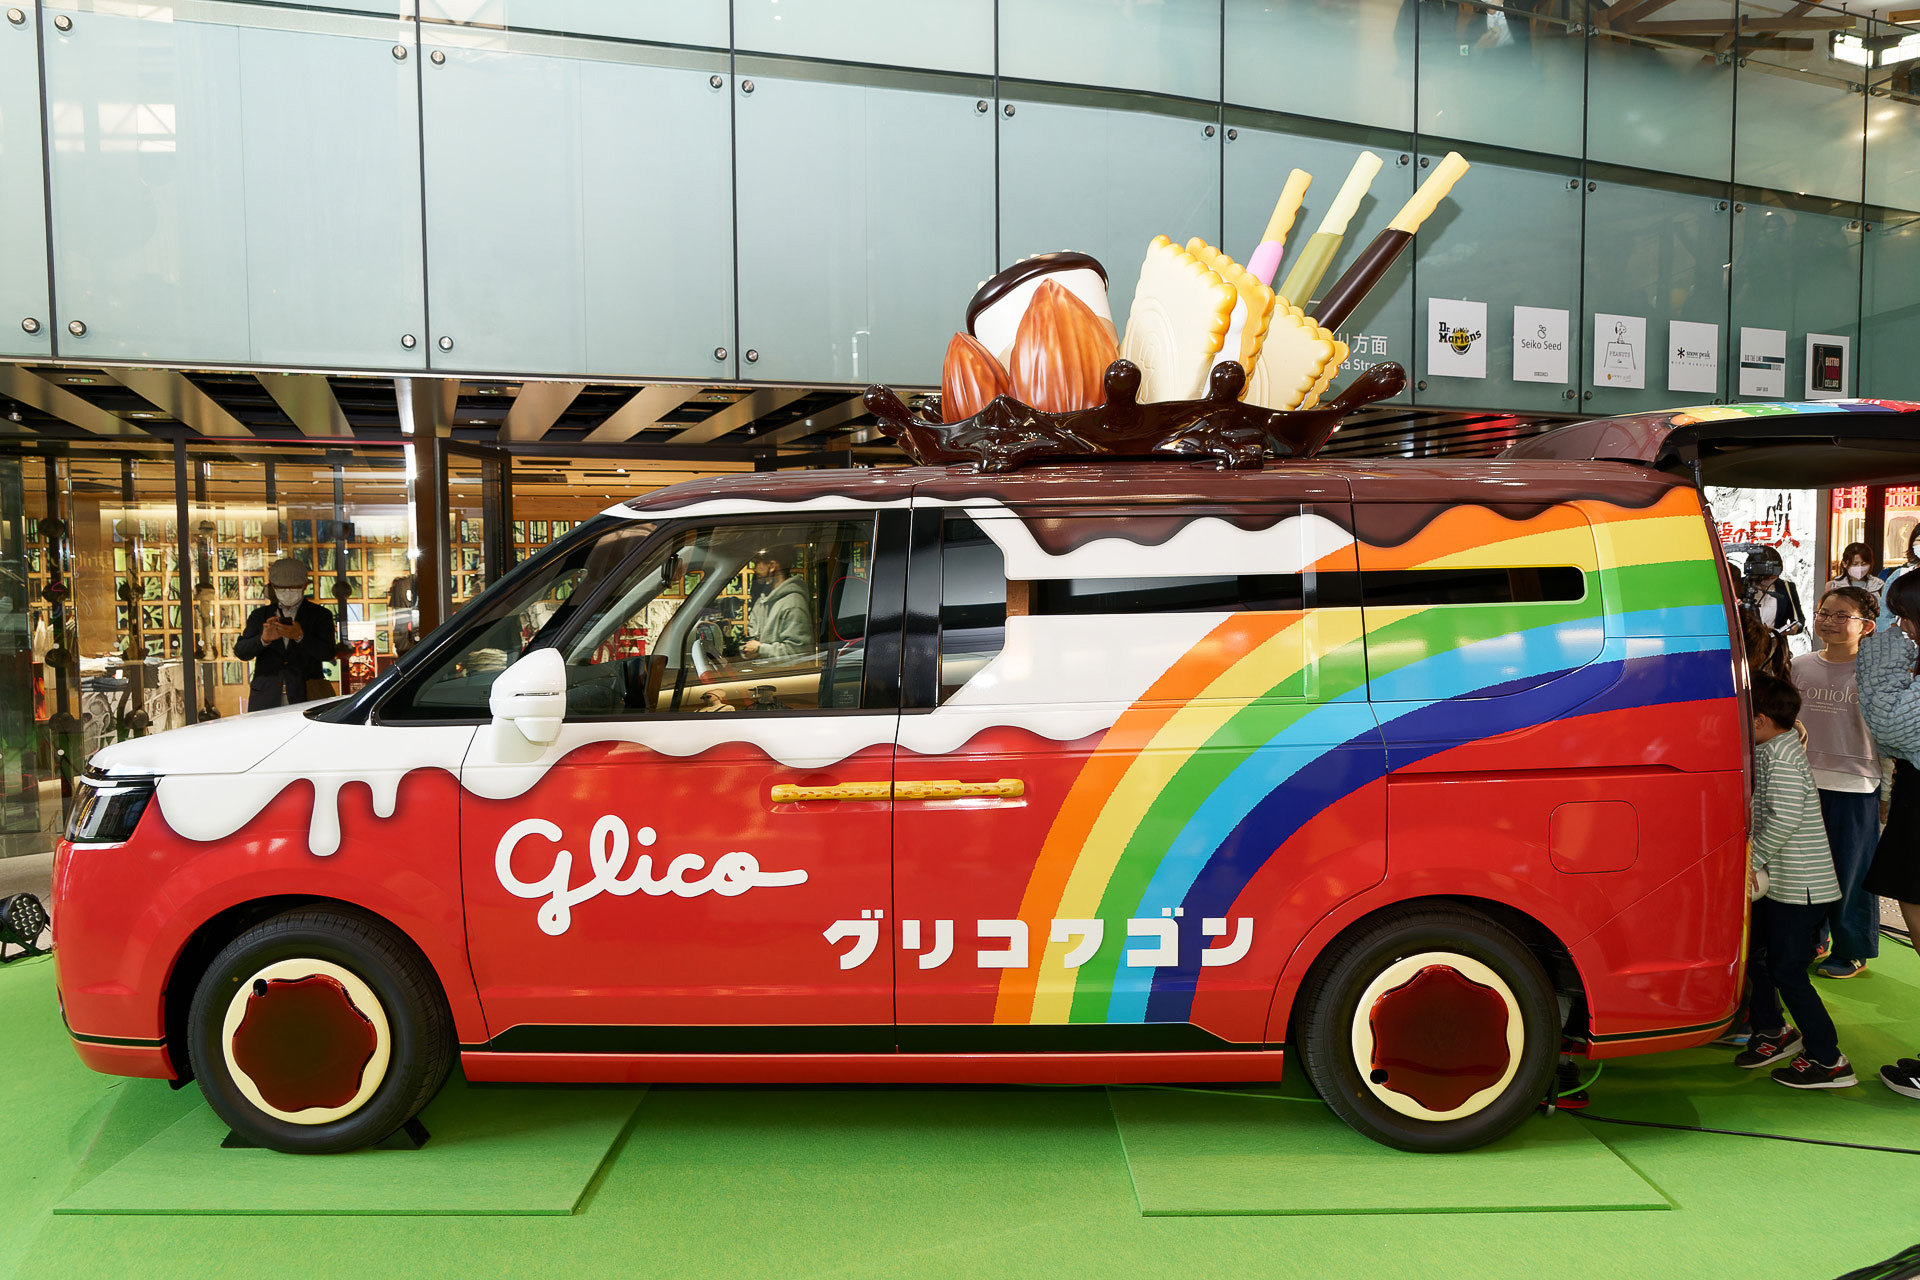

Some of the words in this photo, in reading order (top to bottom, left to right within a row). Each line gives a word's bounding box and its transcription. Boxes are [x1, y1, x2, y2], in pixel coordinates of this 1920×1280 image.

[1438, 329, 1482, 344] Martens
[1521, 338, 1542, 350] Seiko
[1543, 340, 1562, 351] Seed
[1698, 350, 1711, 359] peak
[822, 907, 1255, 971] グリコワゴン
